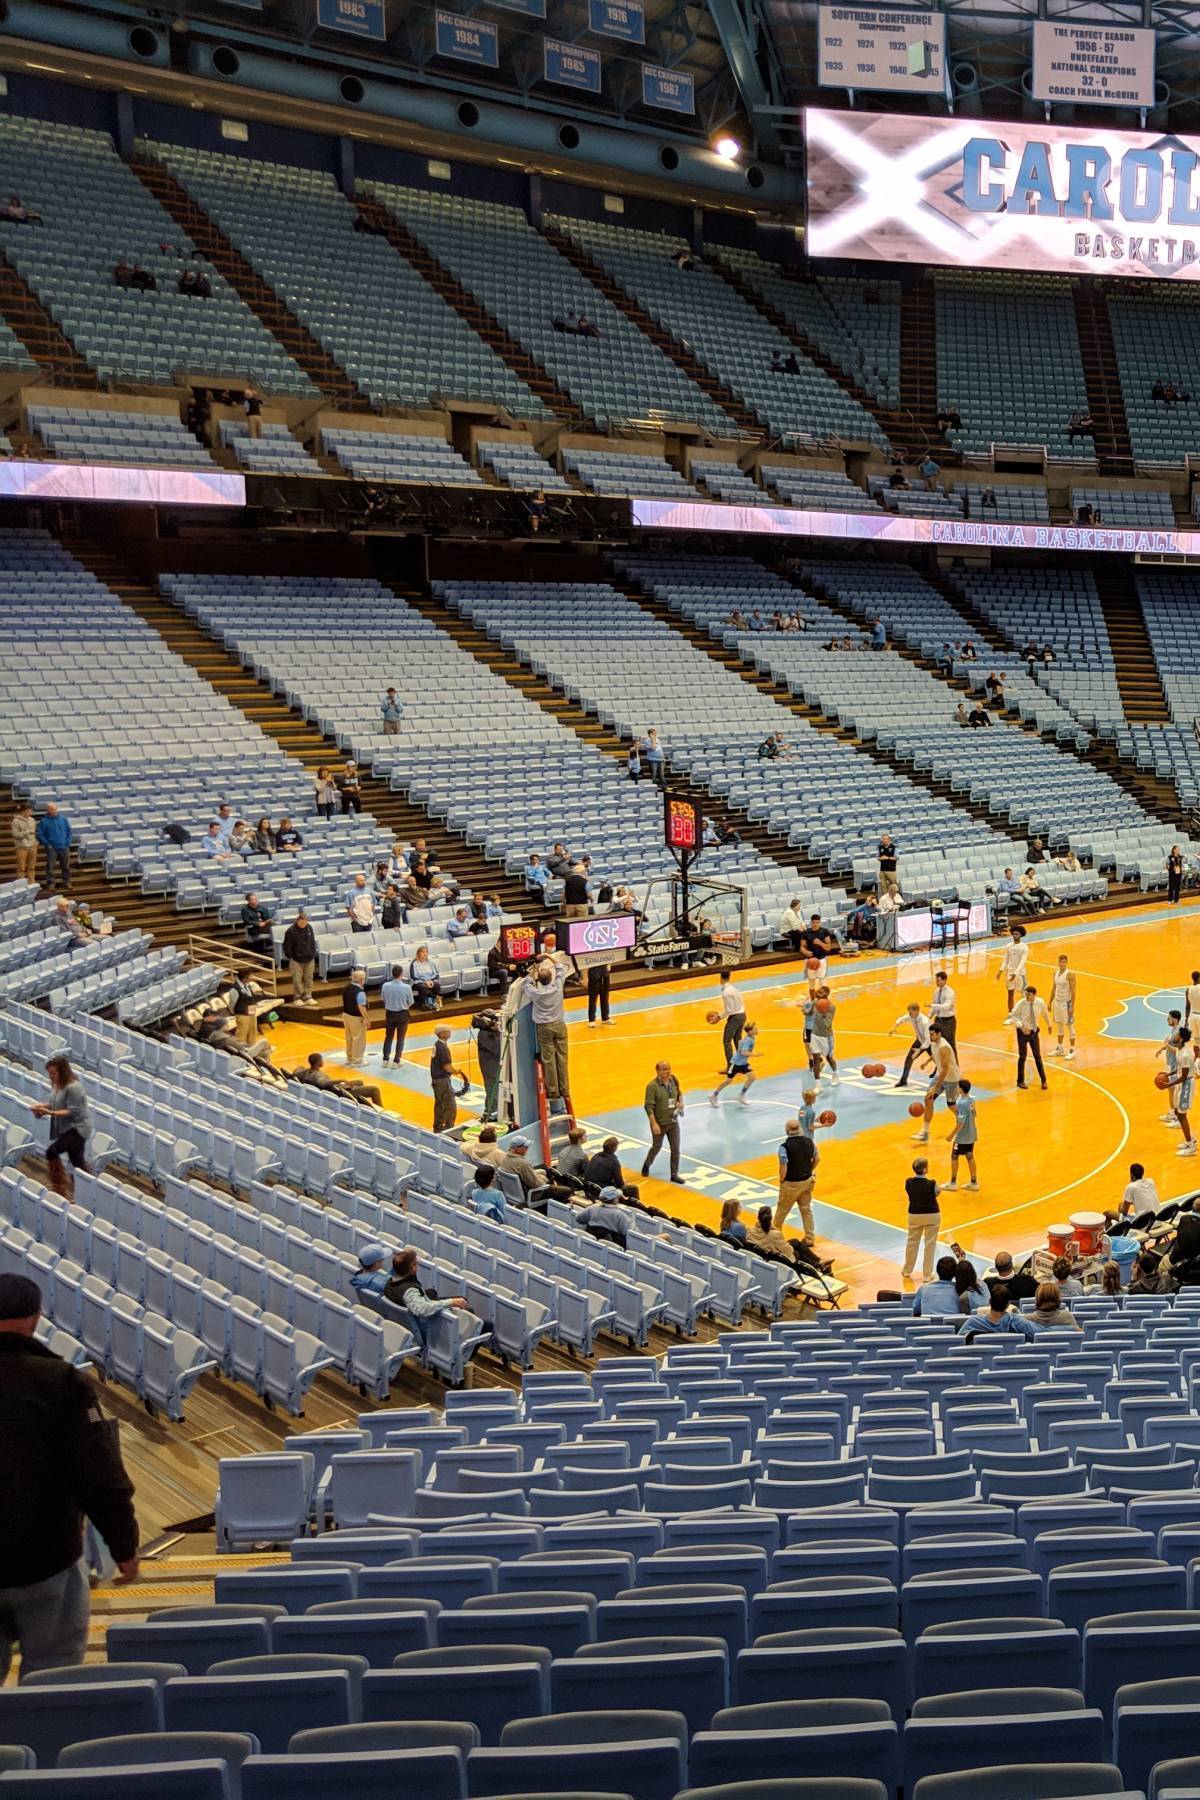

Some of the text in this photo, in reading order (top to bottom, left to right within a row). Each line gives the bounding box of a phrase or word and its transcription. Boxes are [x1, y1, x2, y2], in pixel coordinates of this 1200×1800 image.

[831, 9, 933, 25] SOUTHERN CONFERENCE
[455, 30, 480, 46] 1984
[1054, 28, 1135, 41] THE PERFECT SEASON
[825, 37, 842, 47] 1922
[857, 40, 874, 48] 1924
[1075, 41, 1097, 52] 1956
[1104, 43, 1115, 53] 57
[1070, 52, 1118, 64] UNDEFEATED
[561, 57, 586, 73] 1985
[825, 61, 843, 71] 1935
[1051, 62, 1136, 76] NATIONAL CHAMPIONS
[1082, 75, 1093, 86] 32
[1049, 86, 1075, 96] COACH
[1078, 88, 1102, 97] FRANK
[931, 522, 1179, 553] CAROLINA BASKETBALL
[674, 817, 693, 843] 30
[513, 940, 530, 956] 30
